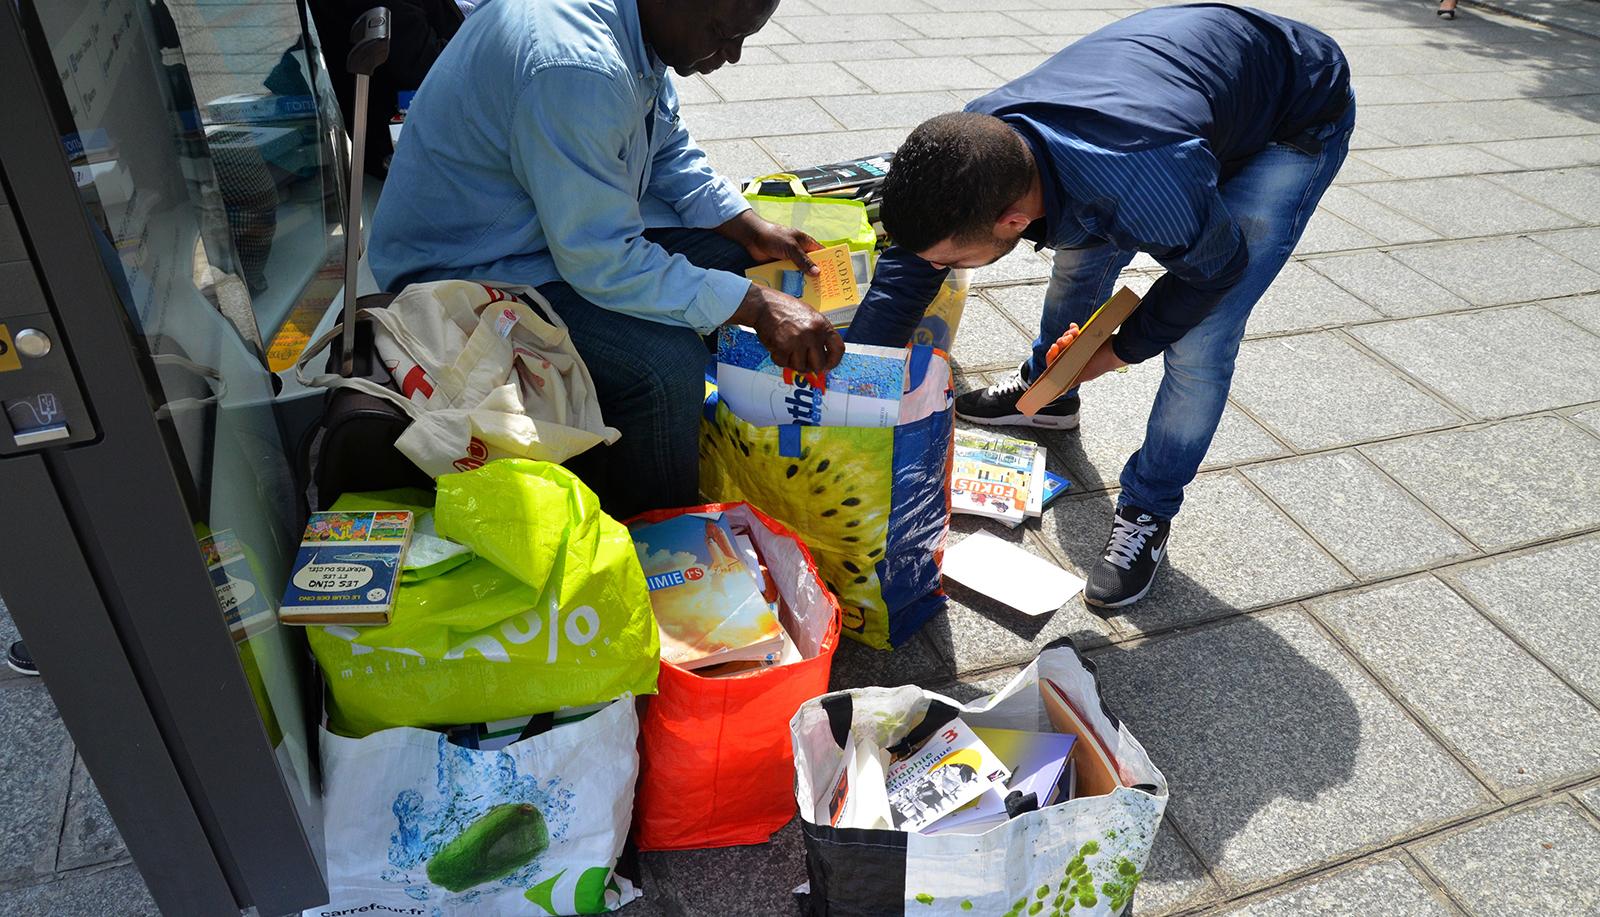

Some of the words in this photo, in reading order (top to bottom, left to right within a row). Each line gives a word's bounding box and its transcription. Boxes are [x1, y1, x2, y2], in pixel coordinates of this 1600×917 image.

[835, 250, 855, 301] GADREY
[957, 480, 1014, 498] FOKUS
[308, 580, 335, 590] CINQ
[339, 580, 359, 588] LES
[647, 571, 683, 590] IMIE
[917, 746, 953, 774] civique
[321, 902, 425, 917] carrefour.fr
